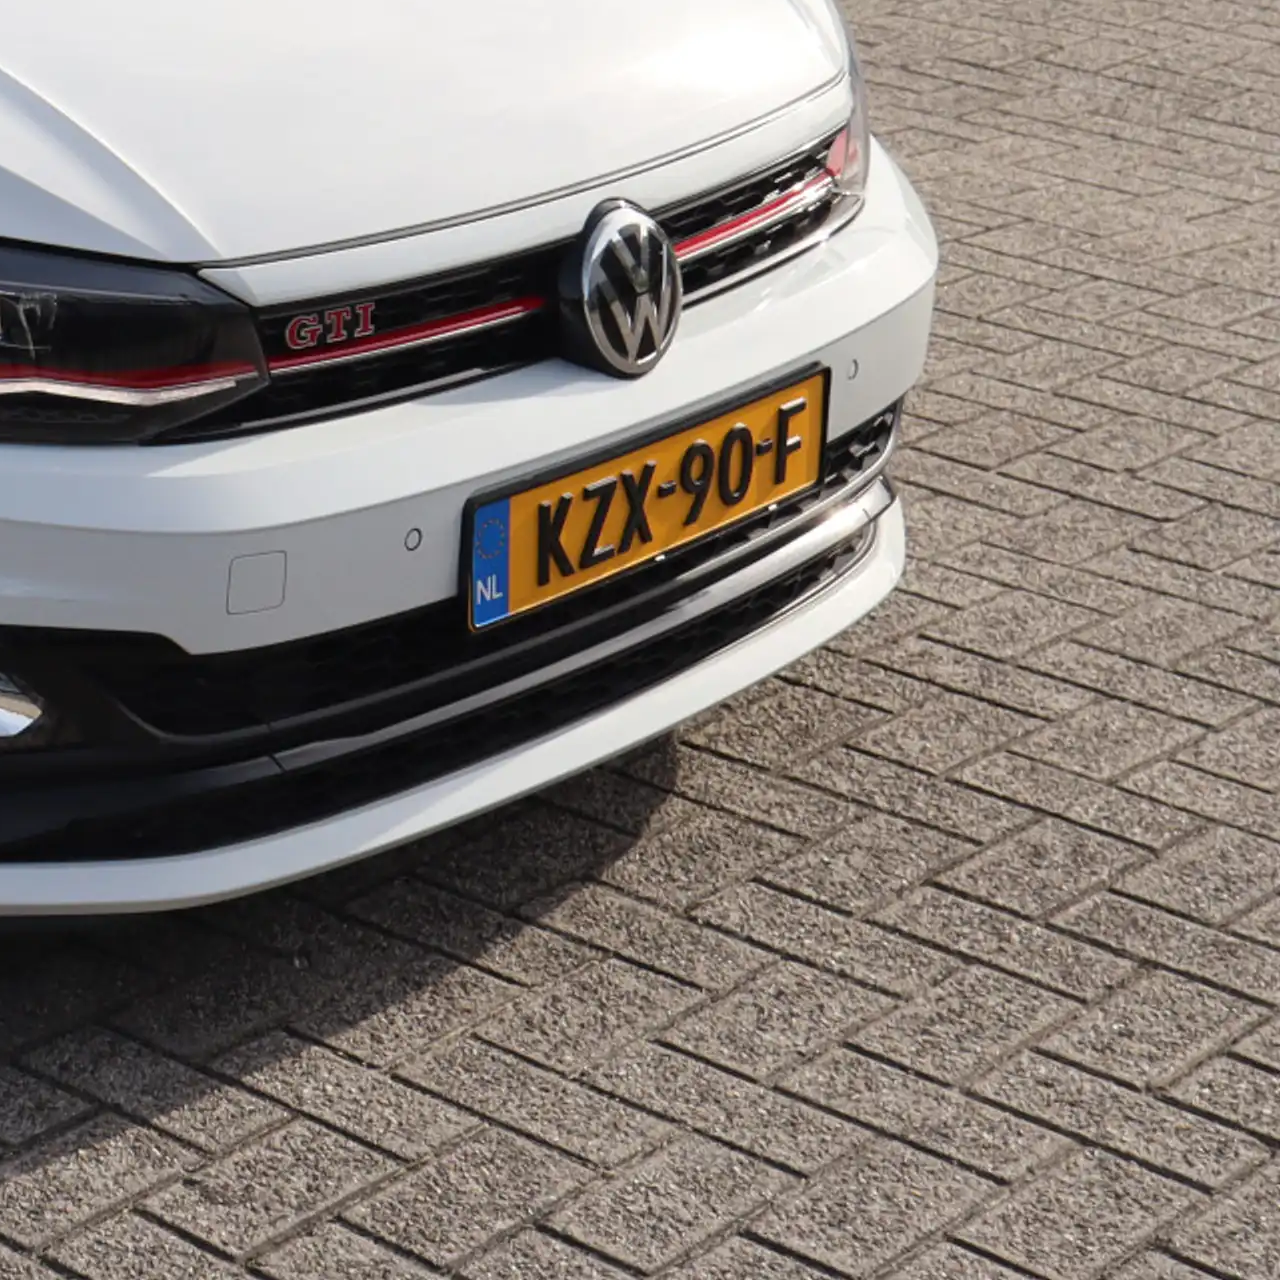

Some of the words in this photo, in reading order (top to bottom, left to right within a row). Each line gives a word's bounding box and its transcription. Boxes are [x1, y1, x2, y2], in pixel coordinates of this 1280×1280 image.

[285, 302, 376, 350] GTI
[536, 396, 808, 587] KZX-90-F
[475, 573, 504, 606] NL
